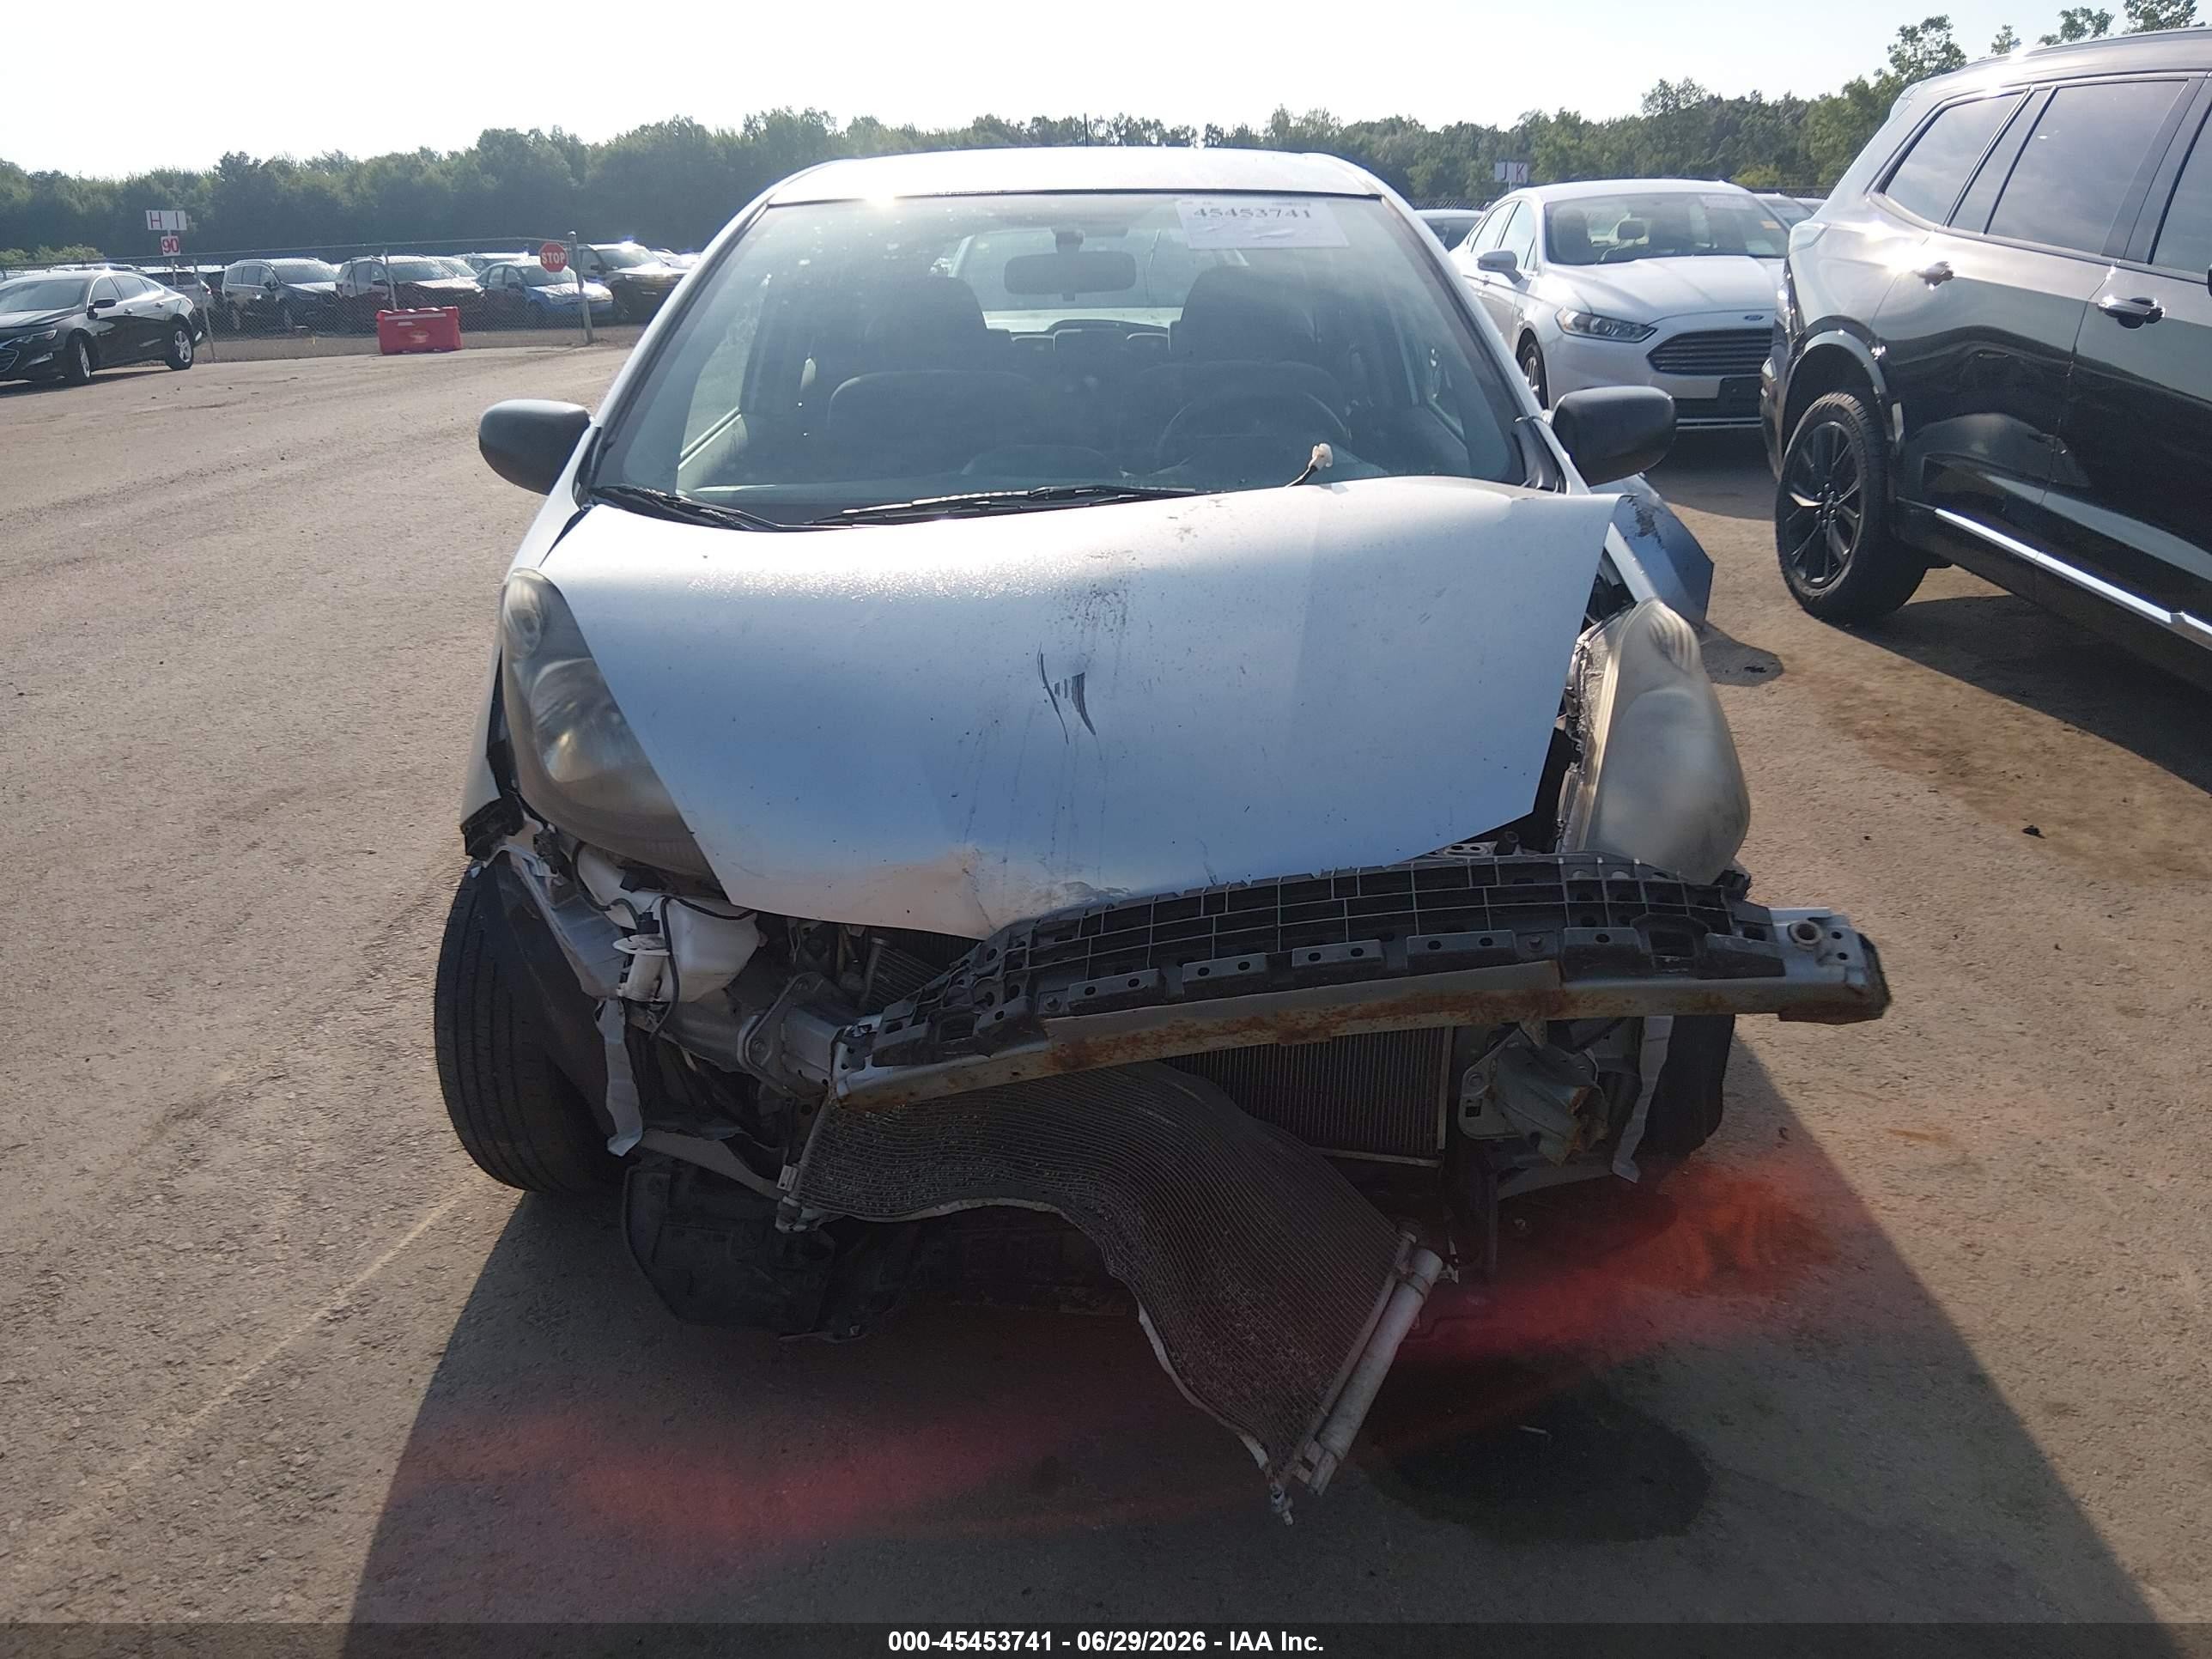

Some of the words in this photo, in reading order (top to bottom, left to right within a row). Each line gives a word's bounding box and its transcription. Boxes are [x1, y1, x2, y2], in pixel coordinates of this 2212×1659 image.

[1516, 164, 1525, 181] K
[149, 211, 162, 228] H
[1194, 208, 1311, 219] 45453741
[162, 238, 179, 252] 90
[541, 252, 565, 264] STOP
